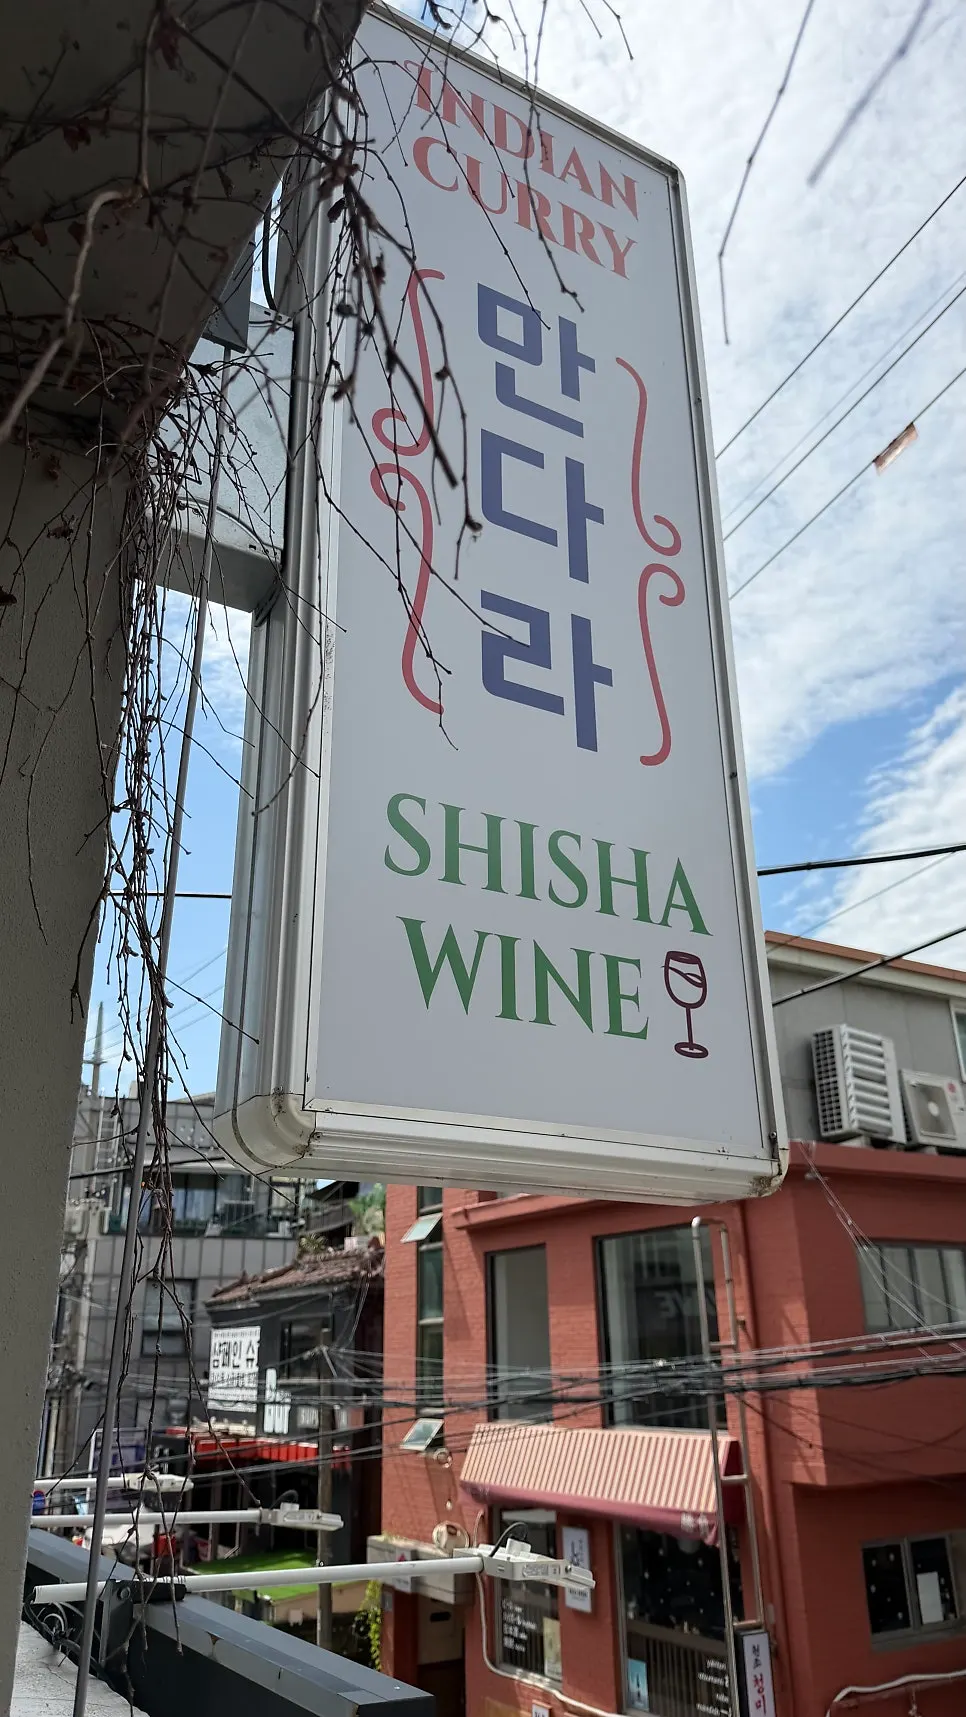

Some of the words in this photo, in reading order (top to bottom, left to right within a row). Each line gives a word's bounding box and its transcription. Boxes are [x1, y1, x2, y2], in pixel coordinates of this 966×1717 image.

[404, 59, 640, 222] INDIAN
[412, 135, 639, 281] CURRY
[477, 283, 614, 752] 만다라
[383, 792, 713, 936] SHISHA
[396, 915, 649, 1041] WINE
